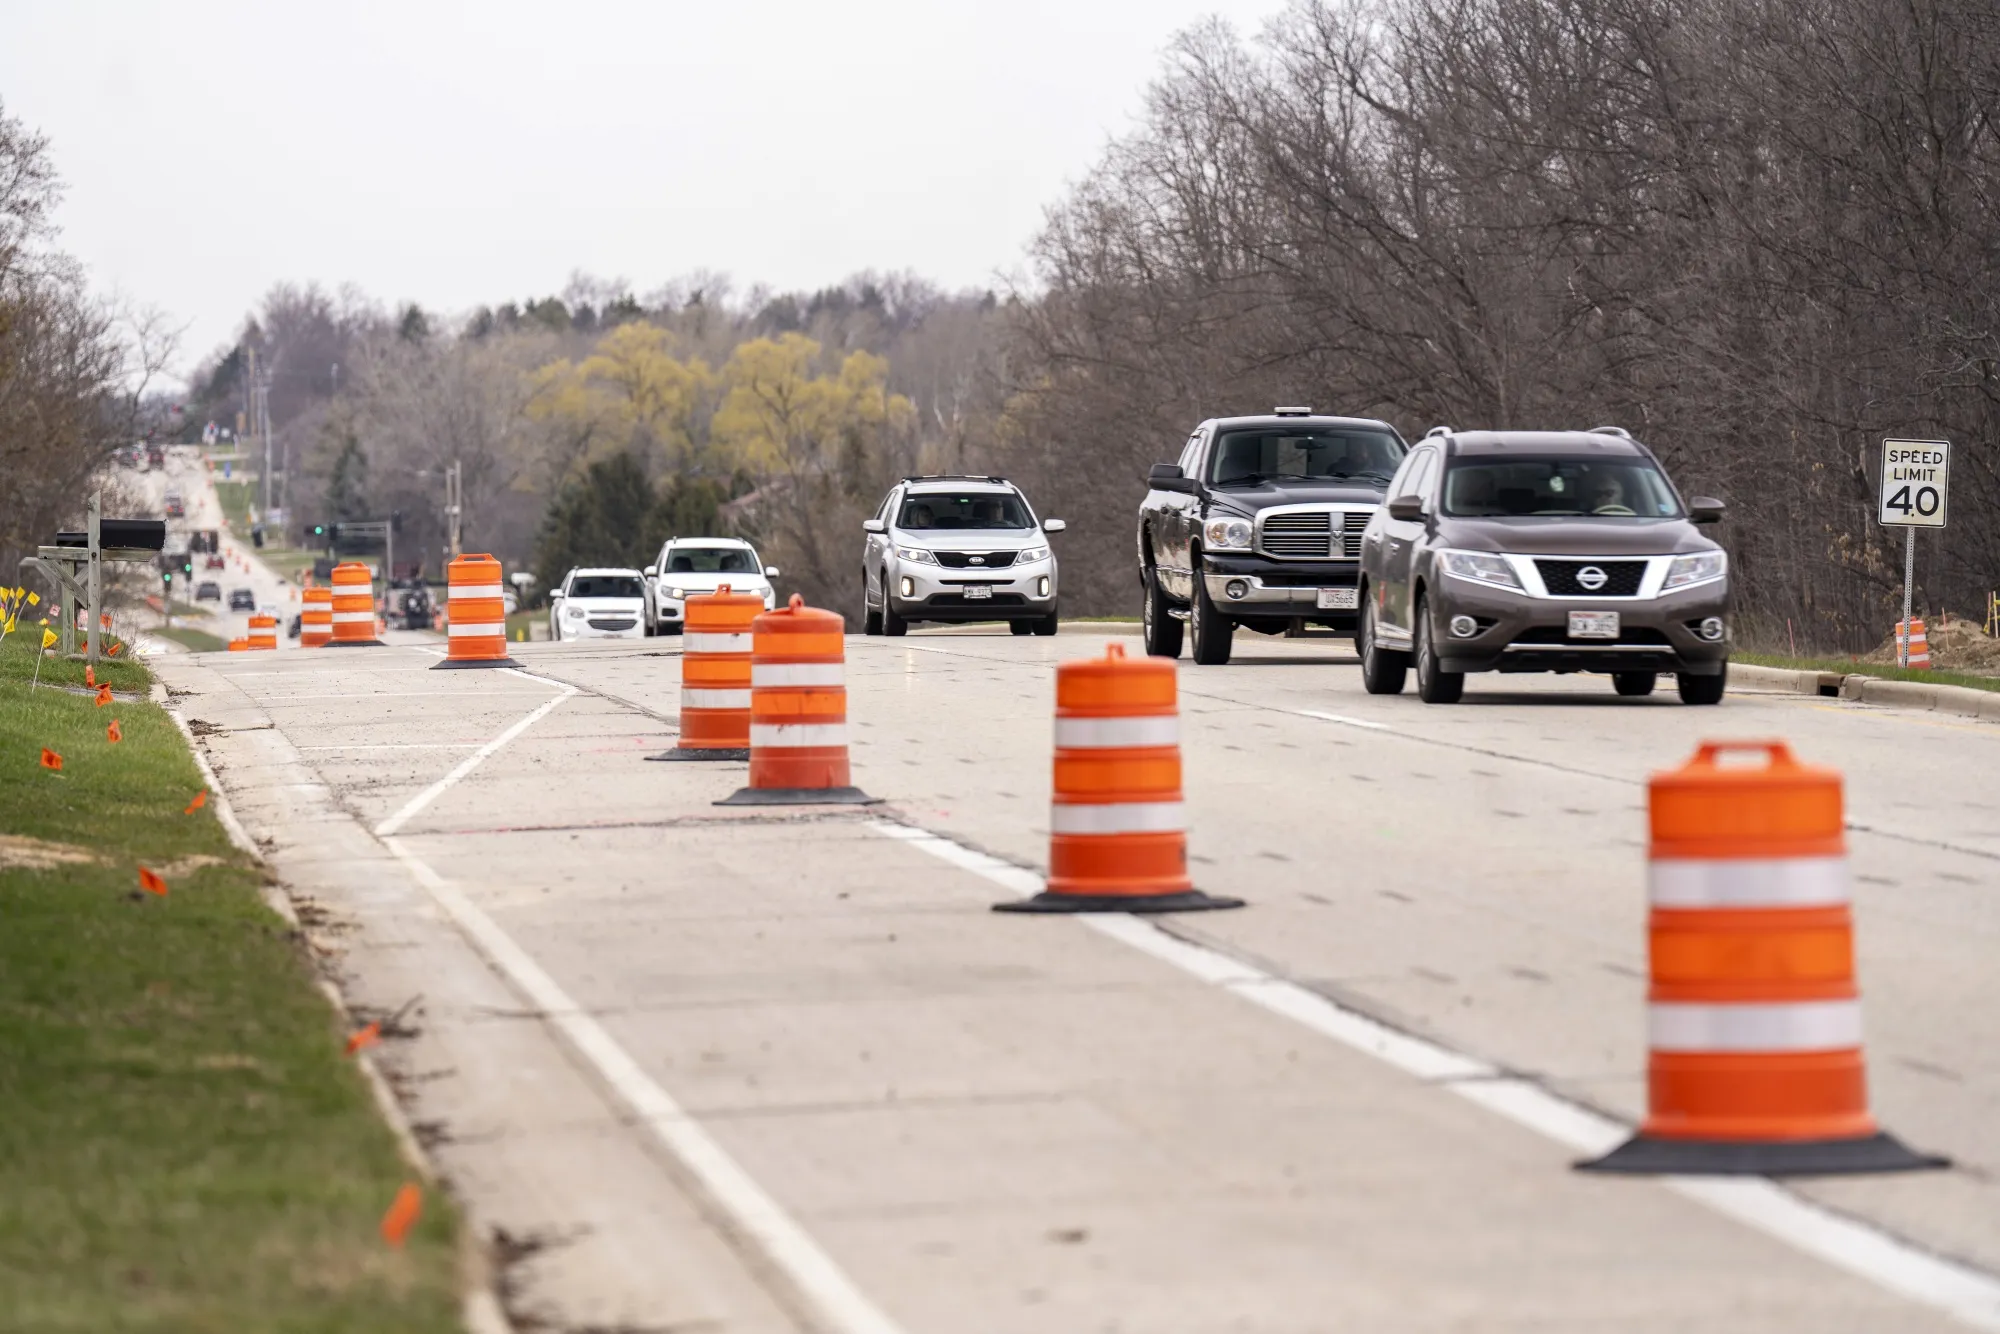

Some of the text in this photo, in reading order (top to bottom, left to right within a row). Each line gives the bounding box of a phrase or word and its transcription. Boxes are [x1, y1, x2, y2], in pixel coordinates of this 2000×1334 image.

[1889, 450, 1943, 464] SPEED
[1894, 468, 1936, 481] LIMIT
[1886, 486, 1939, 516] 40
